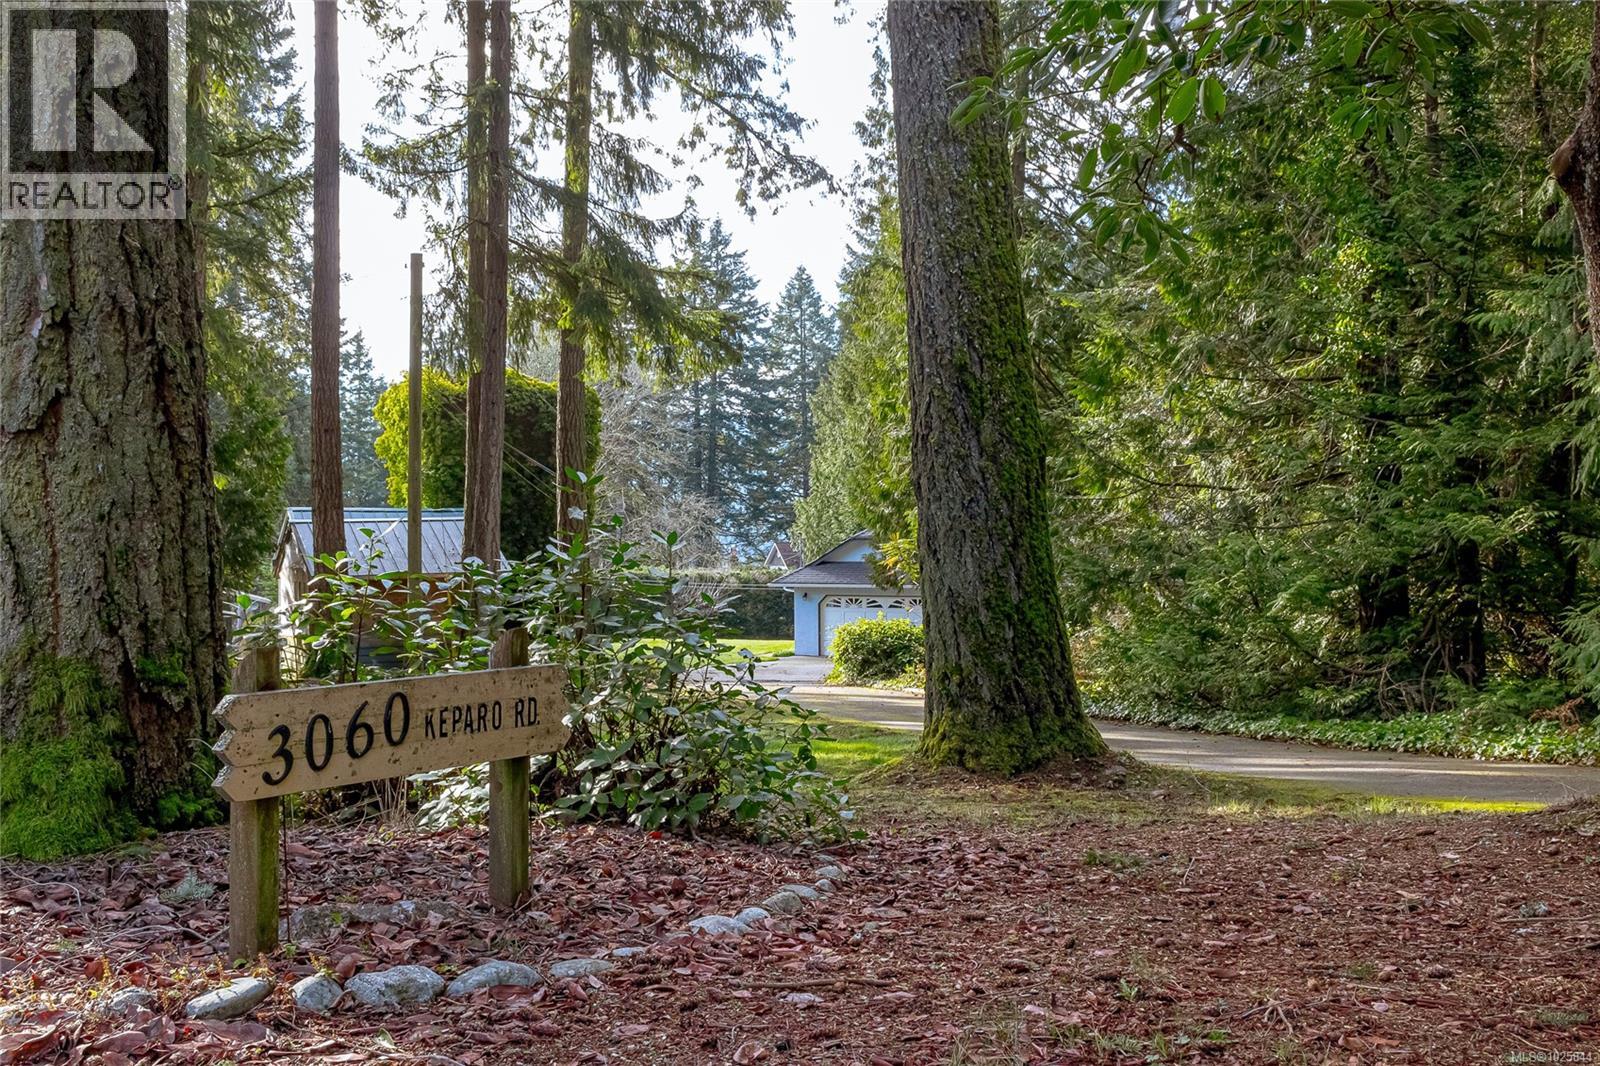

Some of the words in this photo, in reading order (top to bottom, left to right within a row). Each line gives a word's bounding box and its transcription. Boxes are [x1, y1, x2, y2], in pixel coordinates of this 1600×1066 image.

[261, 690, 410, 786] 3060
[424, 699, 502, 739] KEPARO
[514, 696, 541, 729] RD.
